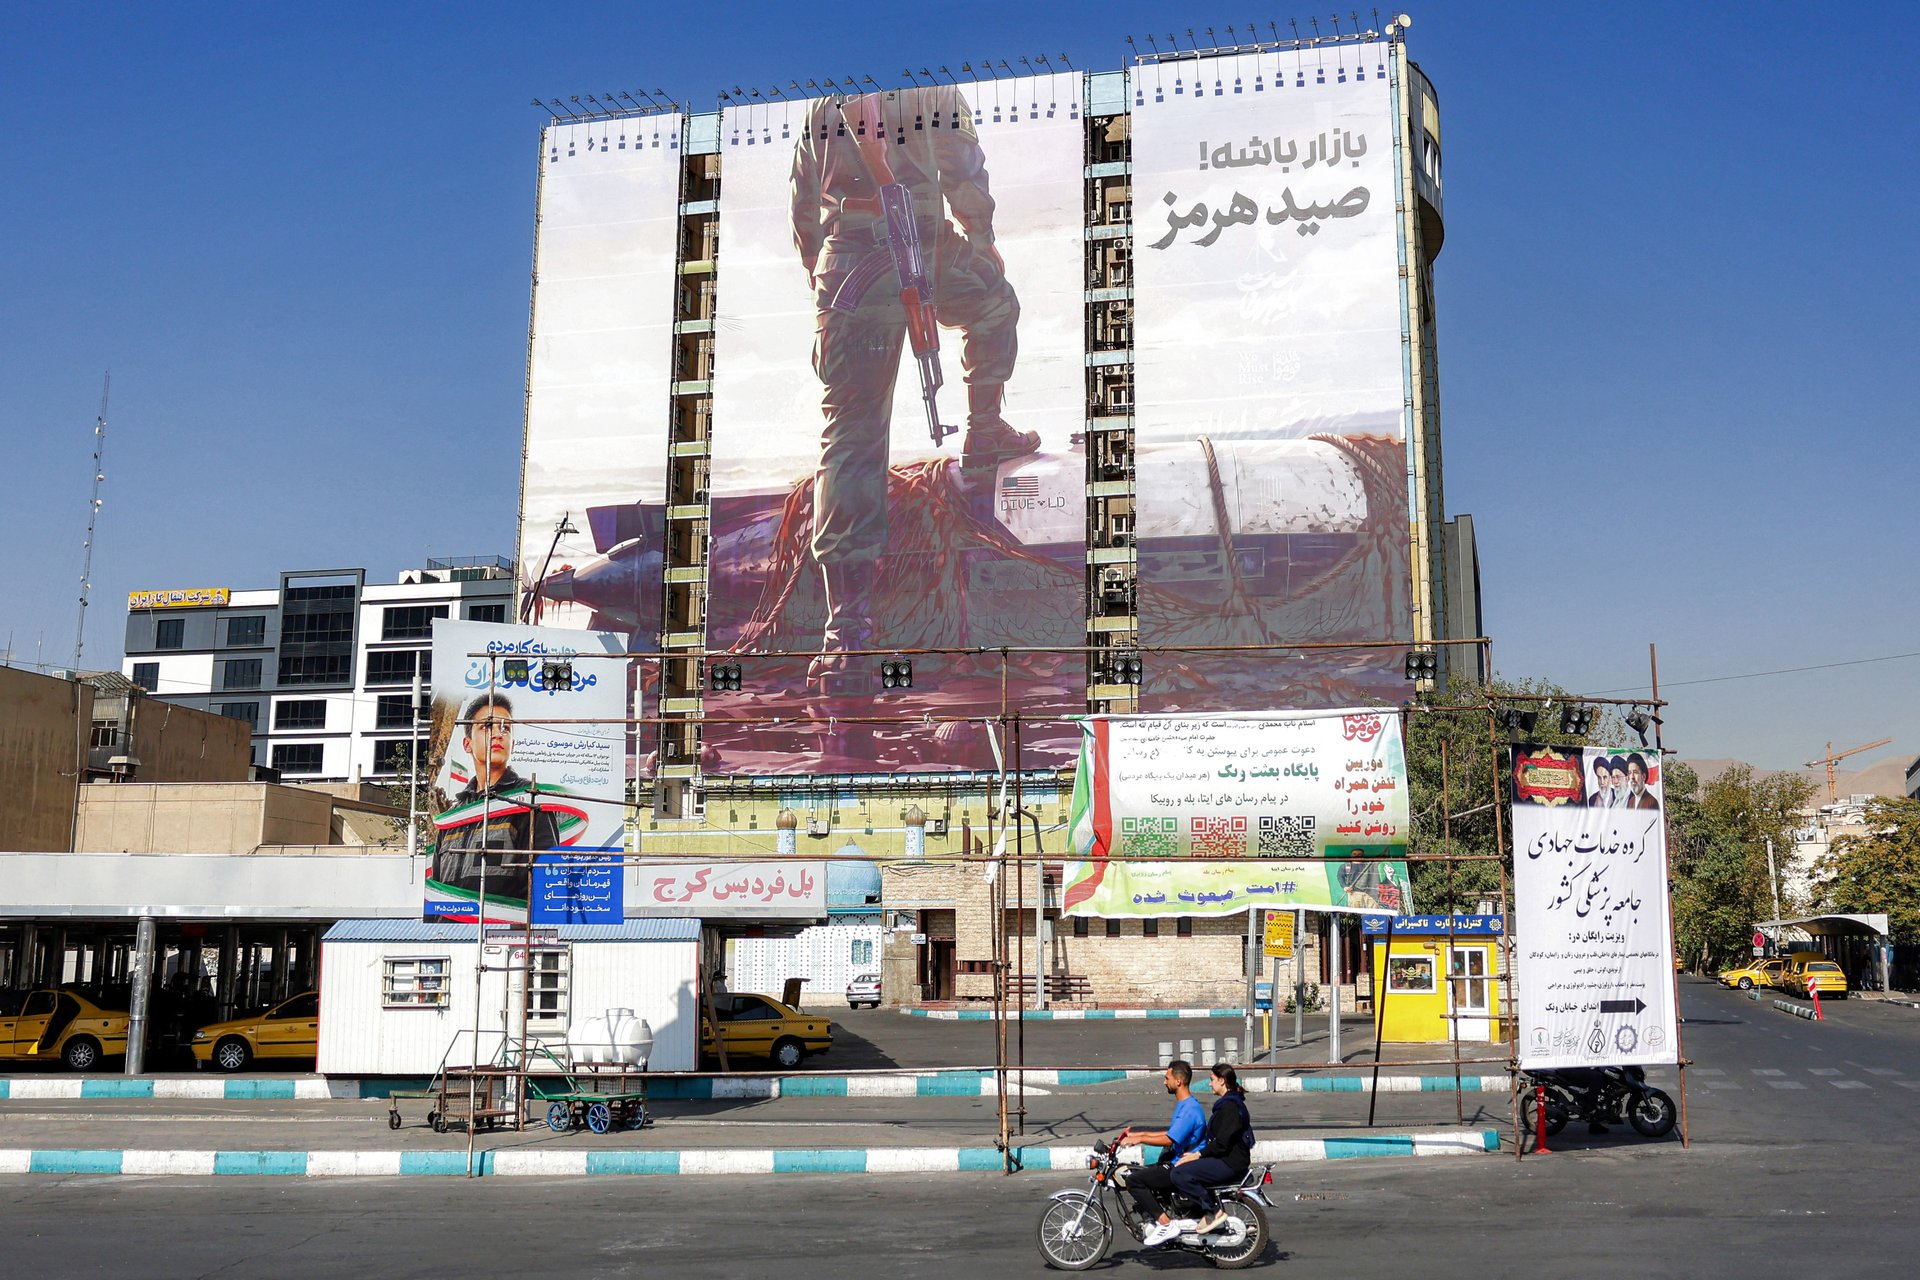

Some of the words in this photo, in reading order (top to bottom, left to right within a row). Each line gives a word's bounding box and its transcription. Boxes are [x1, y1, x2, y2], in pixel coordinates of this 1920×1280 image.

[1199, 135, 1297, 173] باشه!
[1302, 127, 1368, 170] بازار
[1265, 186, 1371, 237] صید
[1145, 190, 1259, 250] هرمز
[187, 591, 210, 604] شرکت
[514, 637, 535, 654] کار
[1147, 720, 1162, 732] قیام
[1174, 721, 1190, 732] بنای
[1191, 721, 1201, 731] زیر
[1202, 720, 1209, 728] که
[1211, 720, 1226, 728] است
[1258, 721, 1282, 730] محمدی
[1284, 720, 1297, 729] ناب
[1297, 719, 1316, 731] اسلام
[546, 739, 573, 749] موسوی
[595, 743, 610, 751] سید
[1196, 748, 1205, 757] به
[1239, 747, 1259, 758] برای
[1261, 747, 1288, 757] عمومی
[1290, 746, 1316, 757] دعوت
[1249, 764, 1280, 781] بعثت
[1283, 762, 1320, 781] پایگاه
[1334, 777, 1369, 794] همراه
[1150, 793, 1174, 806] روبیکا
[1176, 797, 1182, 806] و
[1183, 794, 1195, 804] بله
[1215, 793, 1232, 806] های
[1235, 794, 1258, 805] رسان
[1260, 793, 1277, 805] پیام
[1280, 794, 1289, 804] در
[1347, 798, 1358, 815] را
[1361, 798, 1385, 815] خود
[1336, 820, 1362, 836] کنید
[1364, 819, 1396, 836] روشن
[1574, 829, 1621, 855] خدمات
[1528, 830, 1574, 867] جهادی
[560, 866, 588, 875] ایران
[587, 868, 611, 877] مردم
[545, 878, 574, 889] واقعی
[574, 878, 611, 889] قهرمانان
[652, 867, 712, 902] کرج
[712, 868, 785, 902] فردیس
[788, 868, 814, 899] پل
[1547, 861, 1592, 910] کشور
[544, 890, 589, 902] روزهای
[588, 891, 611, 902] این
[1576, 864, 1612, 926] پزشکی
[446, 905, 461, 913] دولت
[584, 904, 611, 912] سخت
[1612, 888, 1642, 924] جامعه
[1395, 917, 1428, 930] تاکسیرانی
[1457, 920, 1463, 929] و
[1462, 918, 1482, 929] کنترل
[1568, 930, 1581, 944] در:
[1582, 930, 1604, 943] رایگان
[1605, 930, 1625, 943] ویزیت
[1545, 1002, 1559, 1014] ونک
[1559, 1002, 1579, 1014] خیابان
